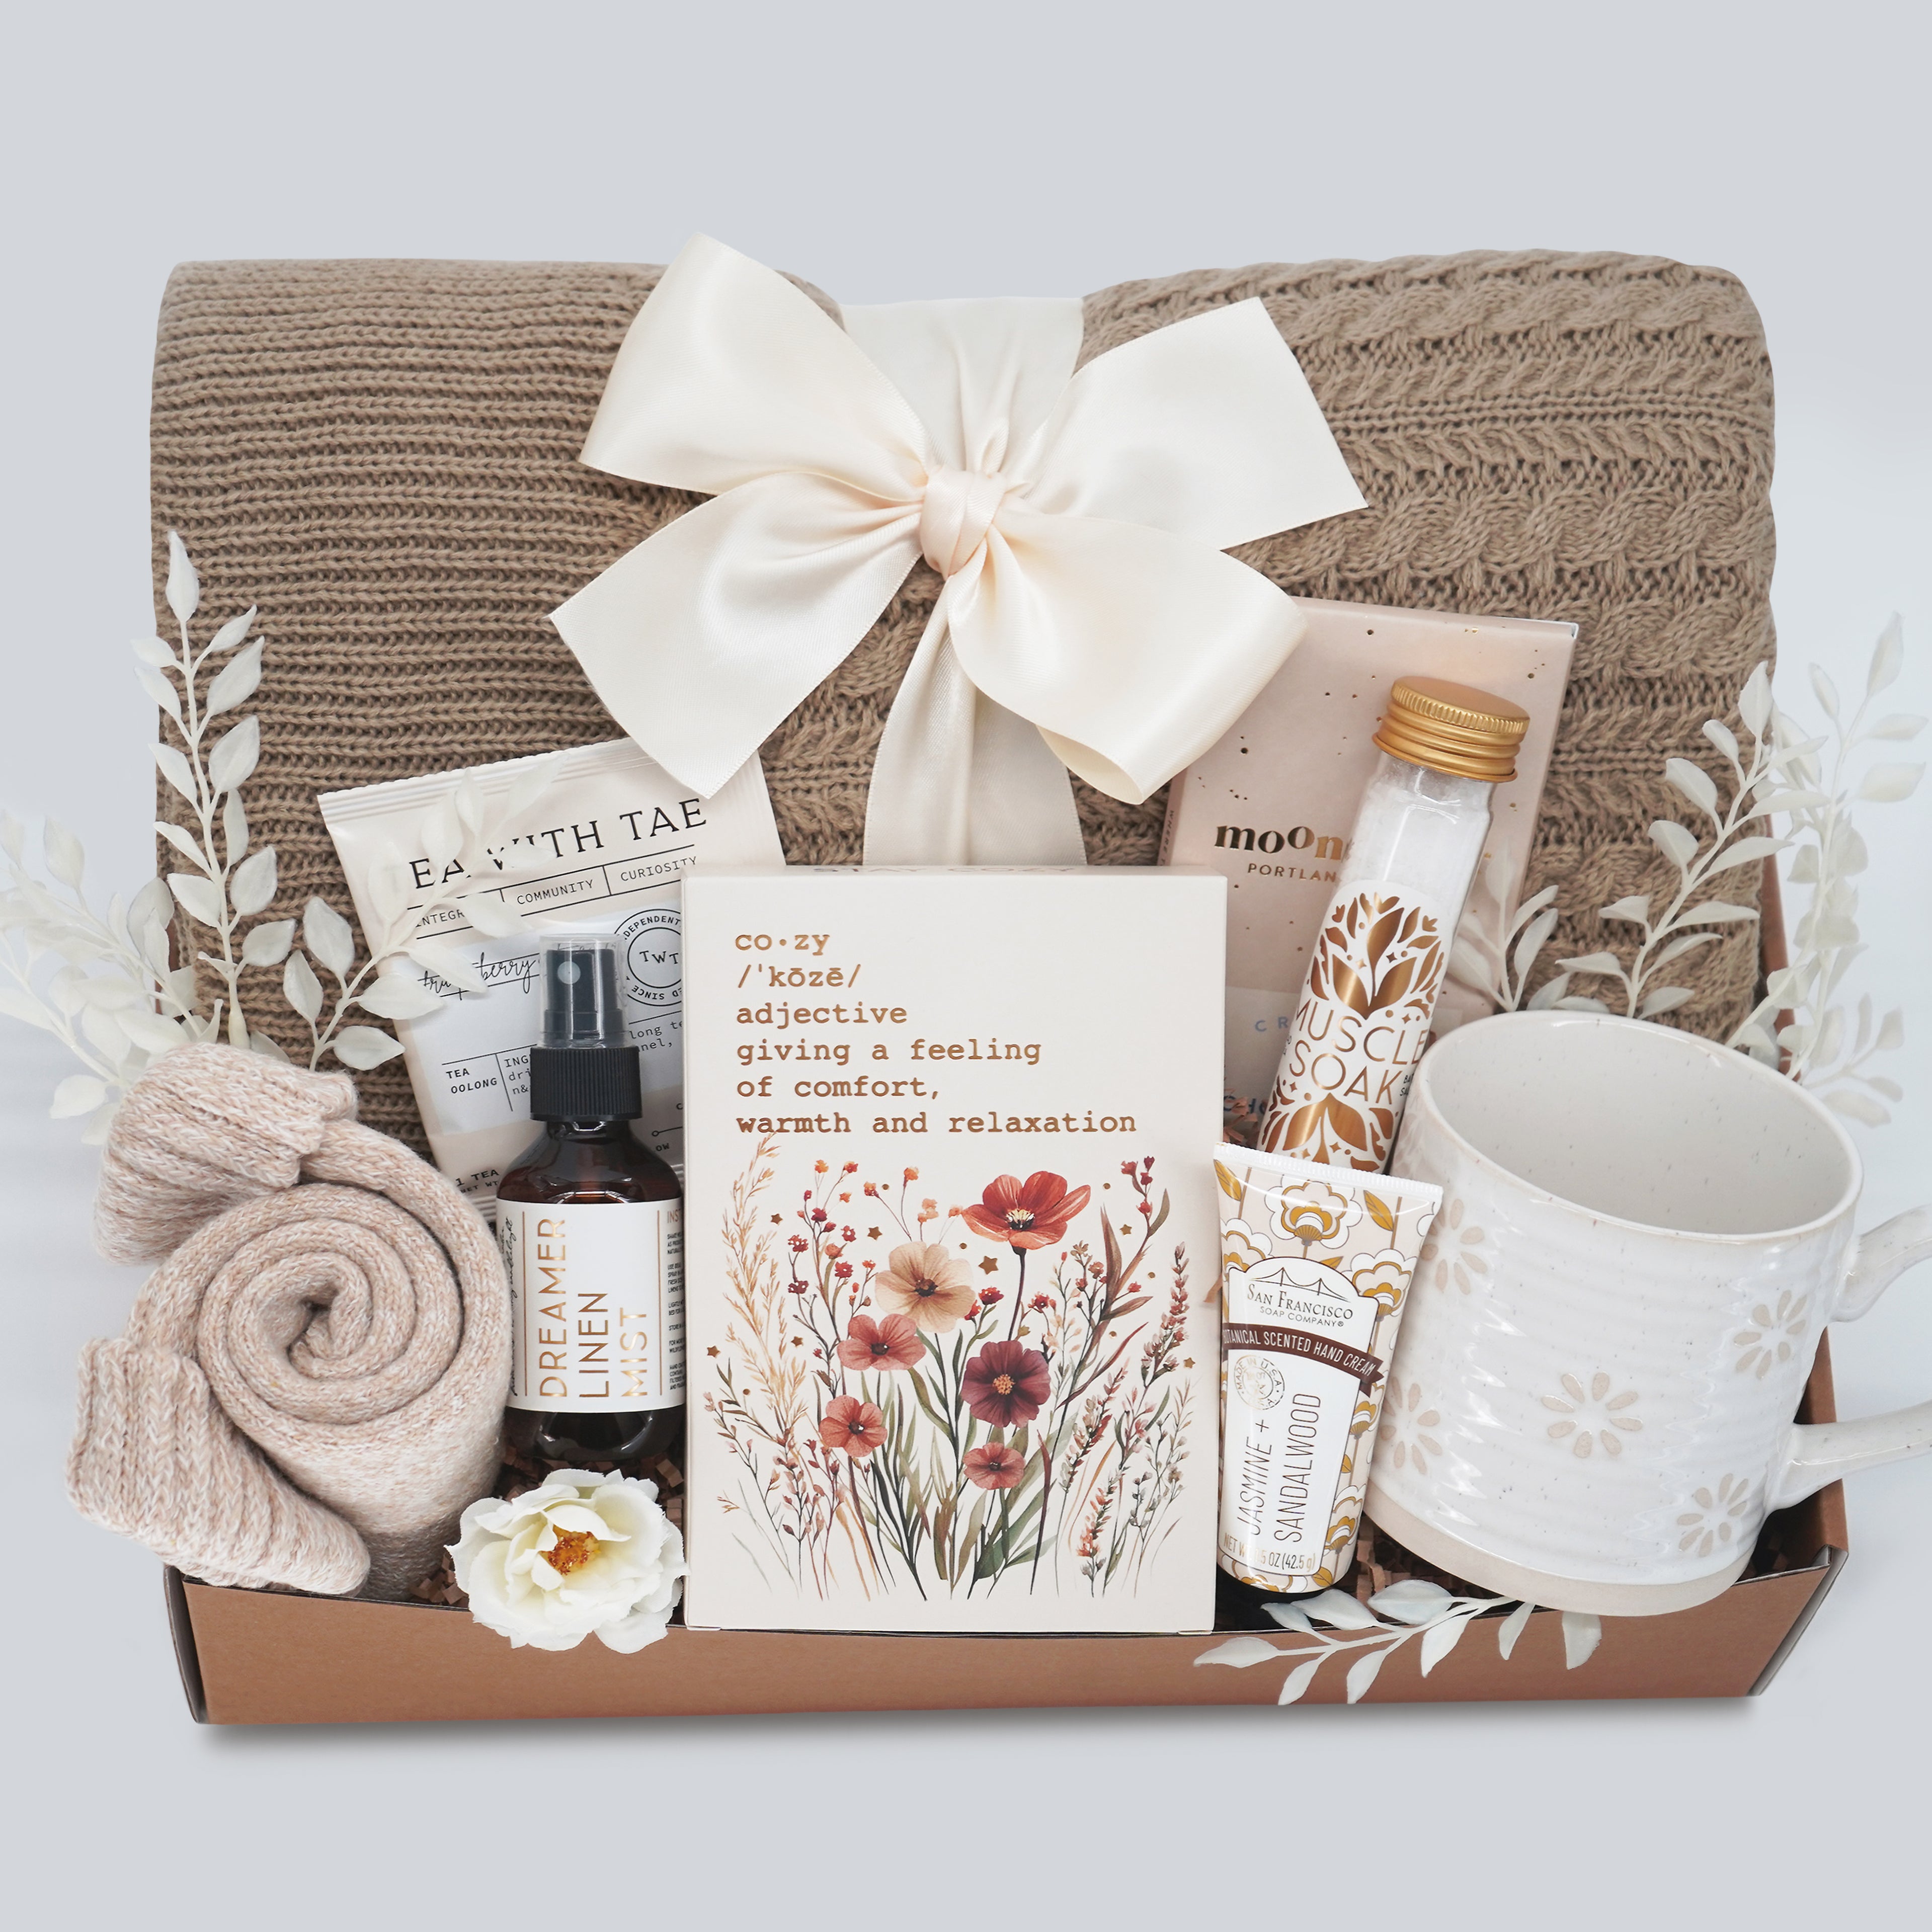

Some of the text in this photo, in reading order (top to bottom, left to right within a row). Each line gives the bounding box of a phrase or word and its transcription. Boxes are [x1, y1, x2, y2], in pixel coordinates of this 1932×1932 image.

[409, 798, 706, 889] EA TH TAE
[1214, 826, 1353, 861] moon
[1248, 863, 1337, 883] PORTLAN
[416, 856, 697, 927] NTEGR COMMUNITY CURIOSITY
[617, 915, 681, 940] DEPENDENT
[639, 950, 679, 964] TWT
[631, 985, 665, 1000] SINCE
[737, 1001, 907, 1029] adjective
[1296, 999, 1429, 1065] MUSCLE
[737, 1038, 1041, 1066] giving a feeling
[446, 1068, 470, 1079] TEA
[451, 1077, 497, 1094] OOLONG
[1289, 1039, 1403, 1105] SOAK
[737, 1075, 938, 1100] of comfort,
[736, 1110, 1136, 1133] warmth and relaxation
[470, 1169, 500, 1181] TEA
[537, 1218, 568, 1397] DREAMER
[1260, 1306, 1284, 1318] SOAP
[578, 1293, 609, 1398] LINEN
[619, 1307, 648, 1397] MIST
[1264, 1331, 1311, 1352] SCENTED
[1313, 1341, 1343, 1362] HAND
[1343, 1353, 1376, 1377] CREAM
[1237, 1436, 1272, 1536] JASMINE
[1224, 1533, 1238, 1553] NET
[1268, 1552, 1281, 1568] OZ
